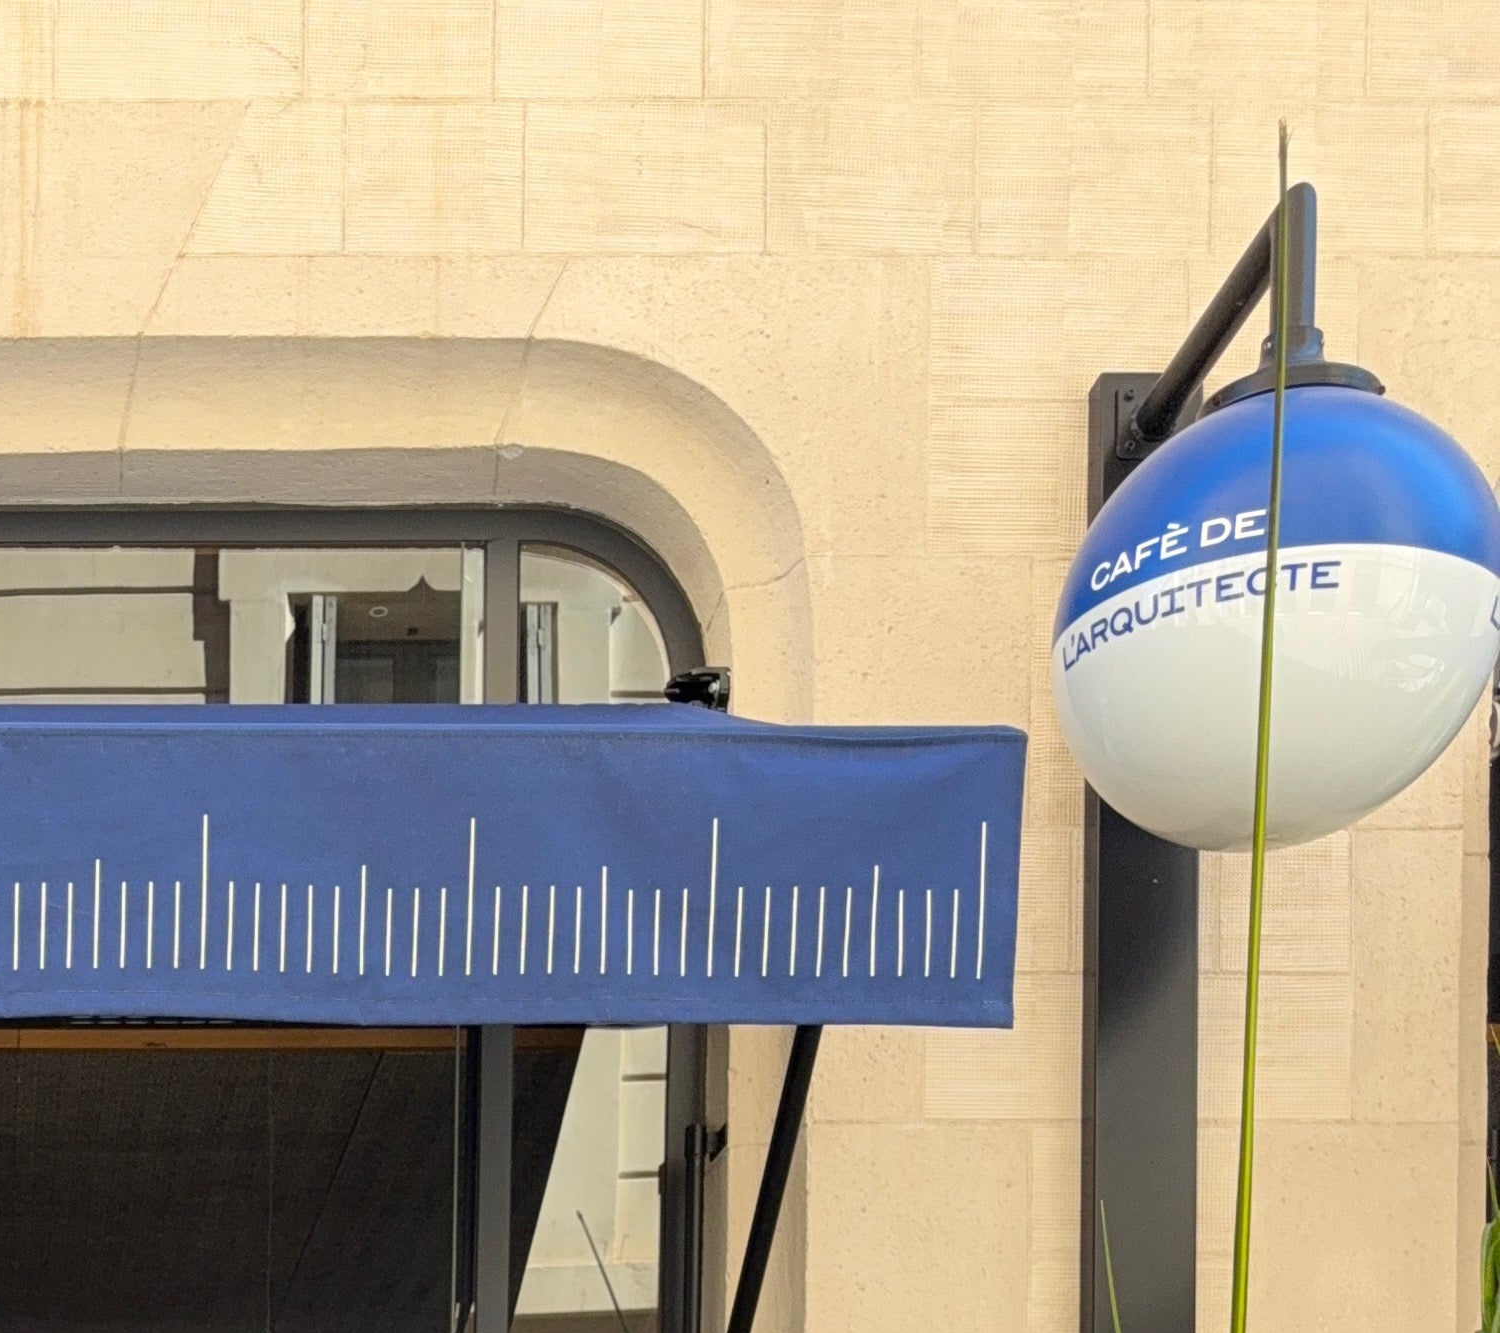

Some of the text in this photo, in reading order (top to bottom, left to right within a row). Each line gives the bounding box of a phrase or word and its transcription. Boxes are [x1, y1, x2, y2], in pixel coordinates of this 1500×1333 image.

[1090, 509, 1267, 592] CAFÈ DE
[1062, 560, 1342, 672] L'ARQUITECTE
